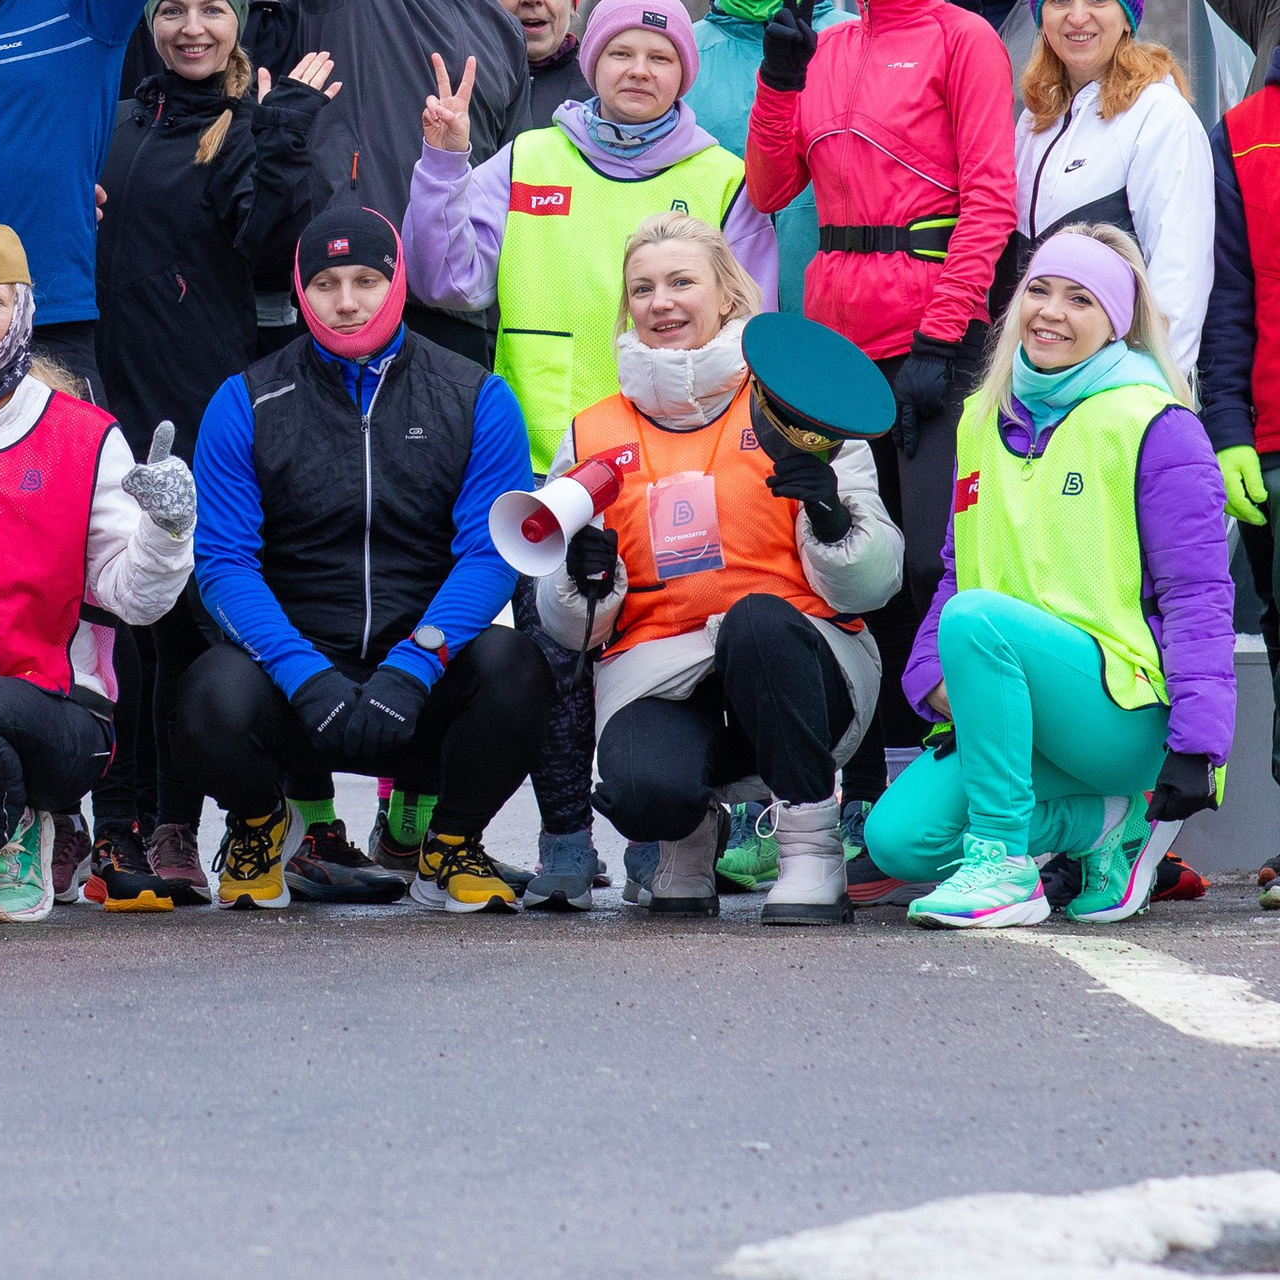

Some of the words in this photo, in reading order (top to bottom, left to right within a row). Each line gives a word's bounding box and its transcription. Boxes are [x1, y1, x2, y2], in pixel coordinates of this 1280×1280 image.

[664, 529, 708, 544] Организатор
[216, 604, 241, 640] VICTORY
[317, 701, 346, 733] MADSHUS
[369, 698, 406, 723] MADSHUS
